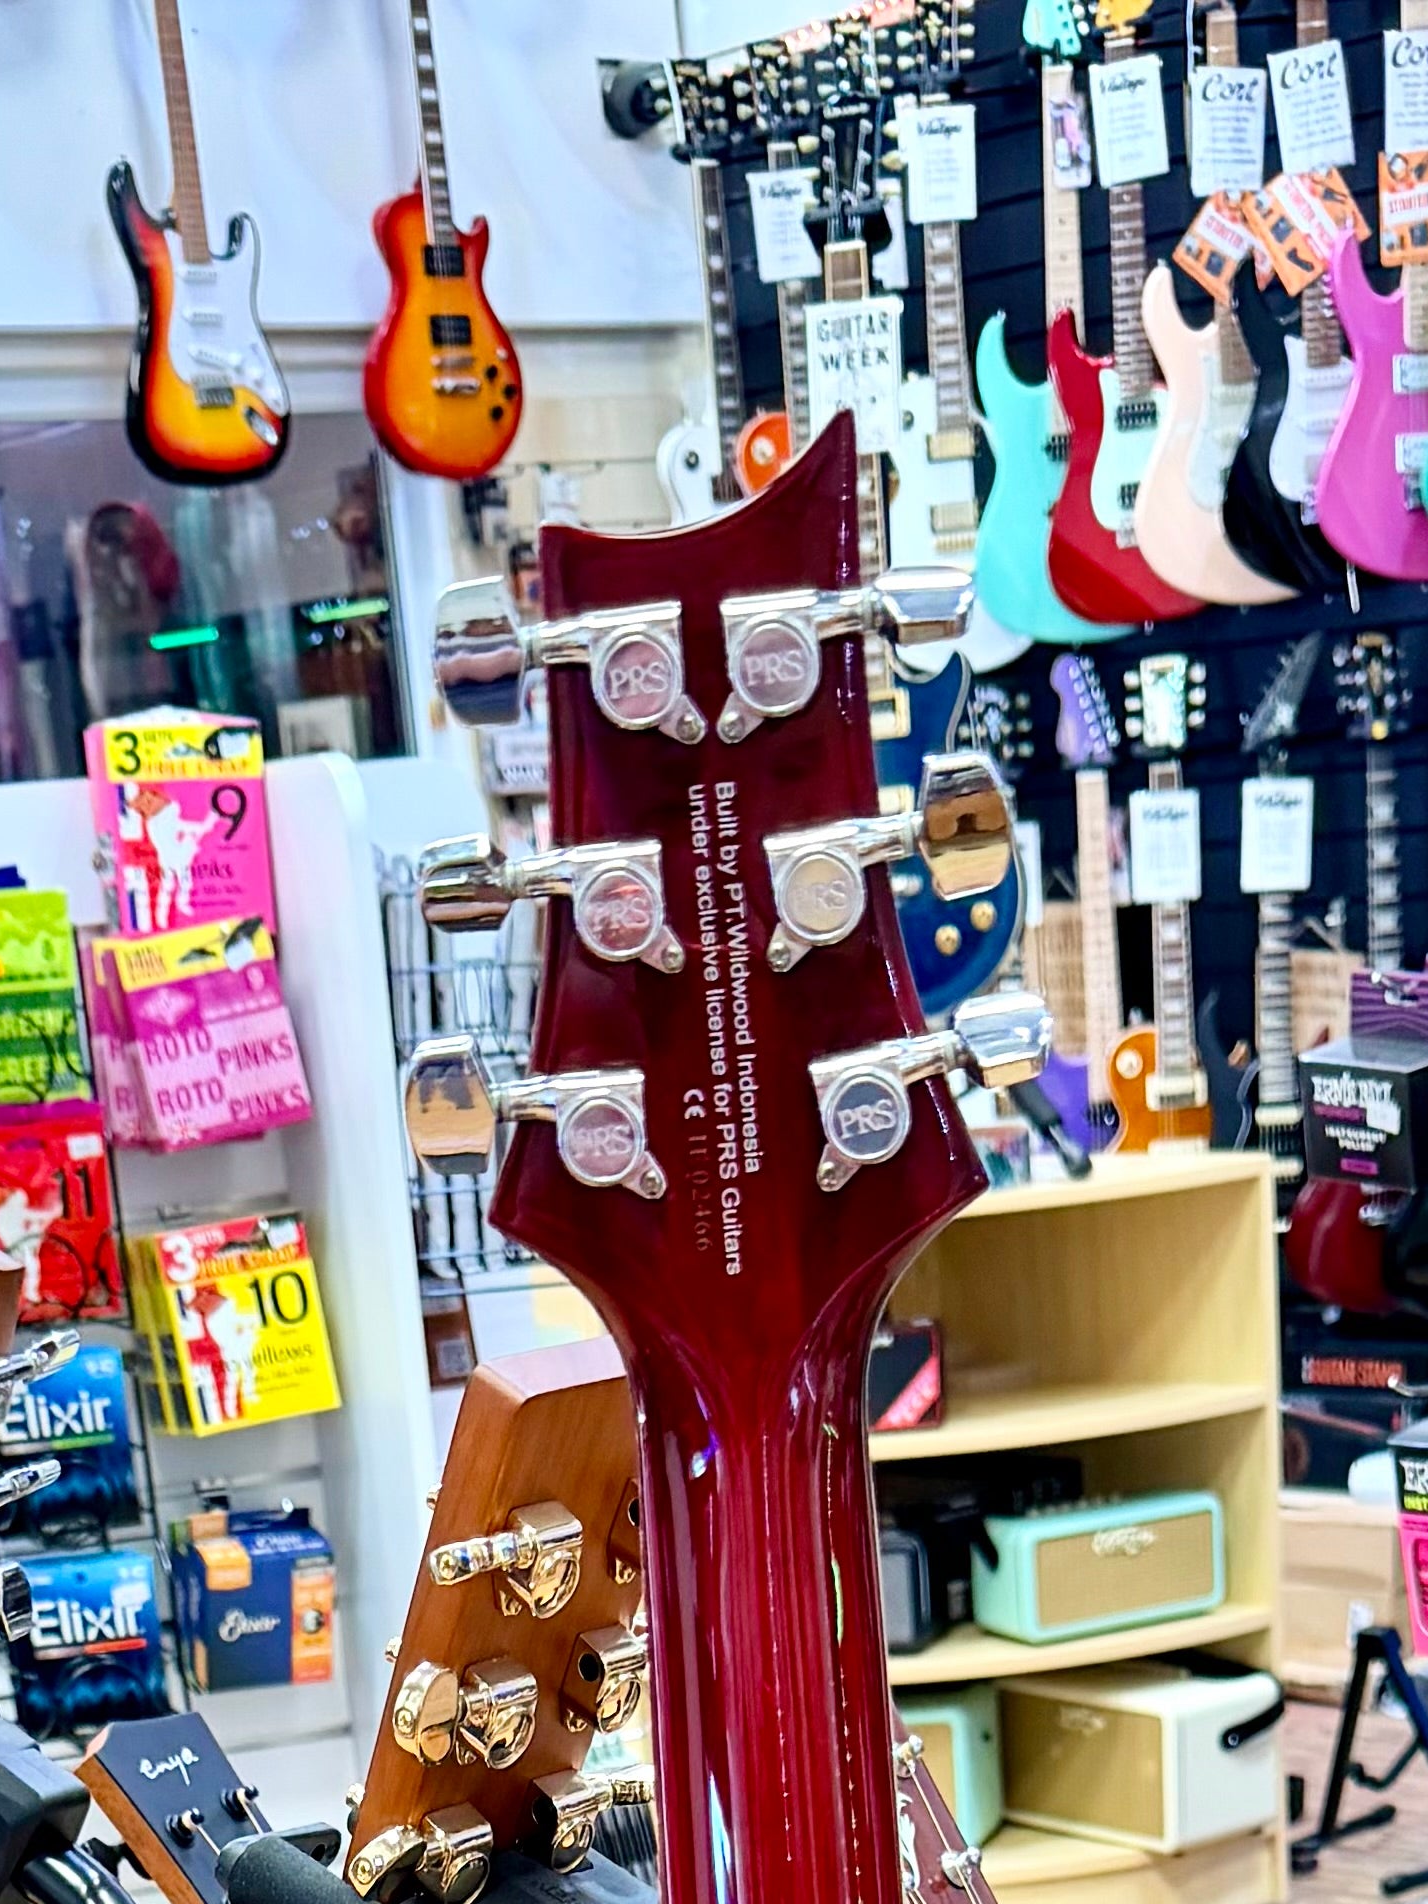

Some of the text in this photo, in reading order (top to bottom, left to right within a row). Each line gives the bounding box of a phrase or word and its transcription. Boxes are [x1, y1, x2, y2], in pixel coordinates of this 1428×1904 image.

[1202, 74, 1260, 102] Cort
[1281, 51, 1337, 89] Cort
[818, 313, 890, 342] GUITAR
[821, 346, 888, 372] WEEK
[610, 661, 668, 699] PRS
[745, 651, 804, 686] PRS
[114, 731, 141, 775] 3
[211, 784, 247, 841] 9
[593, 896, 650, 932] PRS
[794, 880, 847, 911] PRS
[714, 781, 765, 1173] Built by PT.Wildwood Indonesia
[144, 1028, 213, 1066] ROTO
[688, 783, 743, 1276] under exclusive license for PRS Guitars
[217, 1033, 295, 1076] PINKS
[157, 1077, 224, 1117] ROTO
[229, 1083, 306, 1122] PINKS
[837, 1099, 895, 1139] PRS
[53, 1167, 97, 1219] 11
[162, 1234, 199, 1283] 3
[248, 1270, 309, 1329] 10
[0, 1381, 113, 1443] Elixir
[32, 1595, 144, 1648] Elixir
[140, 1745, 200, 1788] enya
